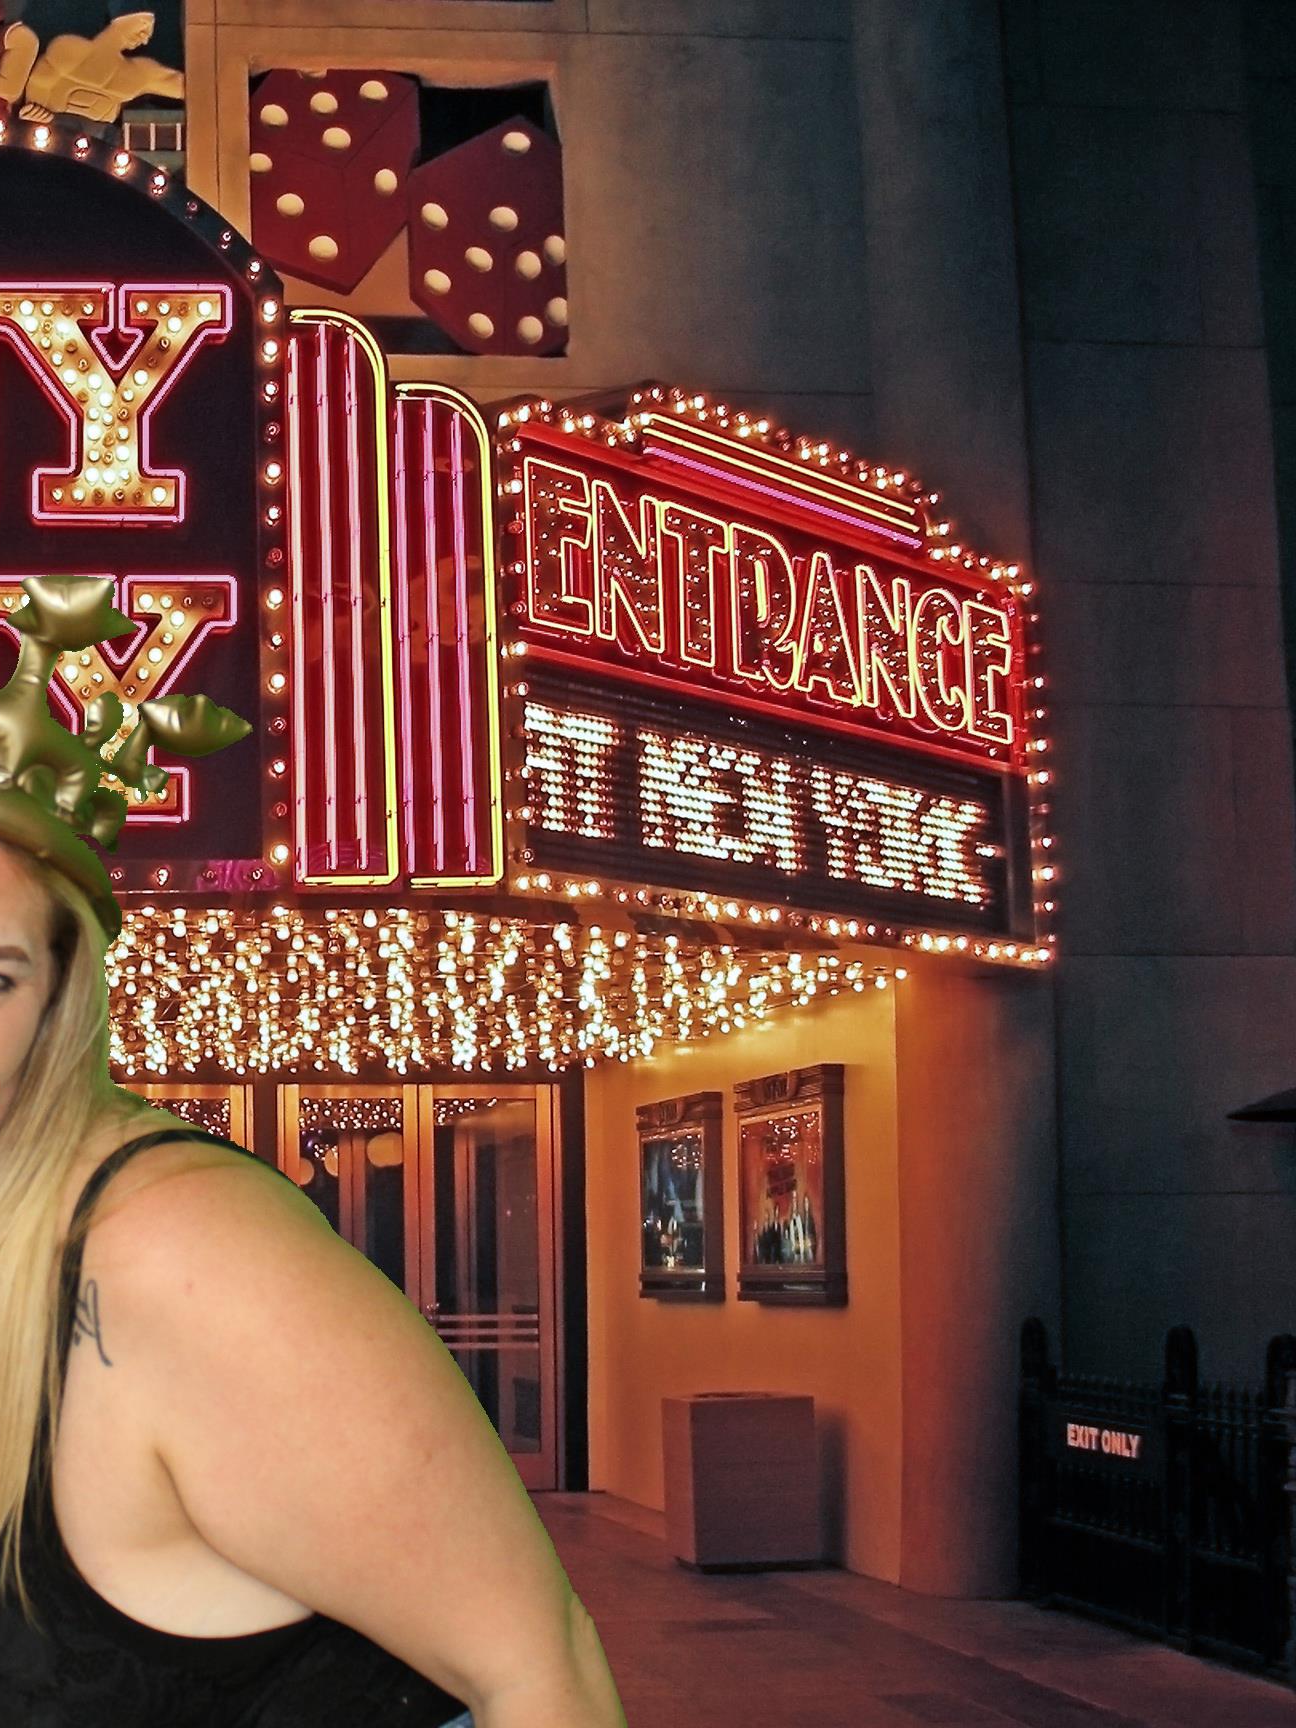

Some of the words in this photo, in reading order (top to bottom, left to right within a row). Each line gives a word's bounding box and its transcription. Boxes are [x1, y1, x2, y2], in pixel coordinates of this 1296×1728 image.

[522, 456, 1014, 744] ENTRANCE
[637, 729, 805, 875] NEW
[811, 764, 990, 906] YORK
[1066, 1423, 1099, 1450] EXIT
[1101, 1430, 1141, 1458] ONLY
